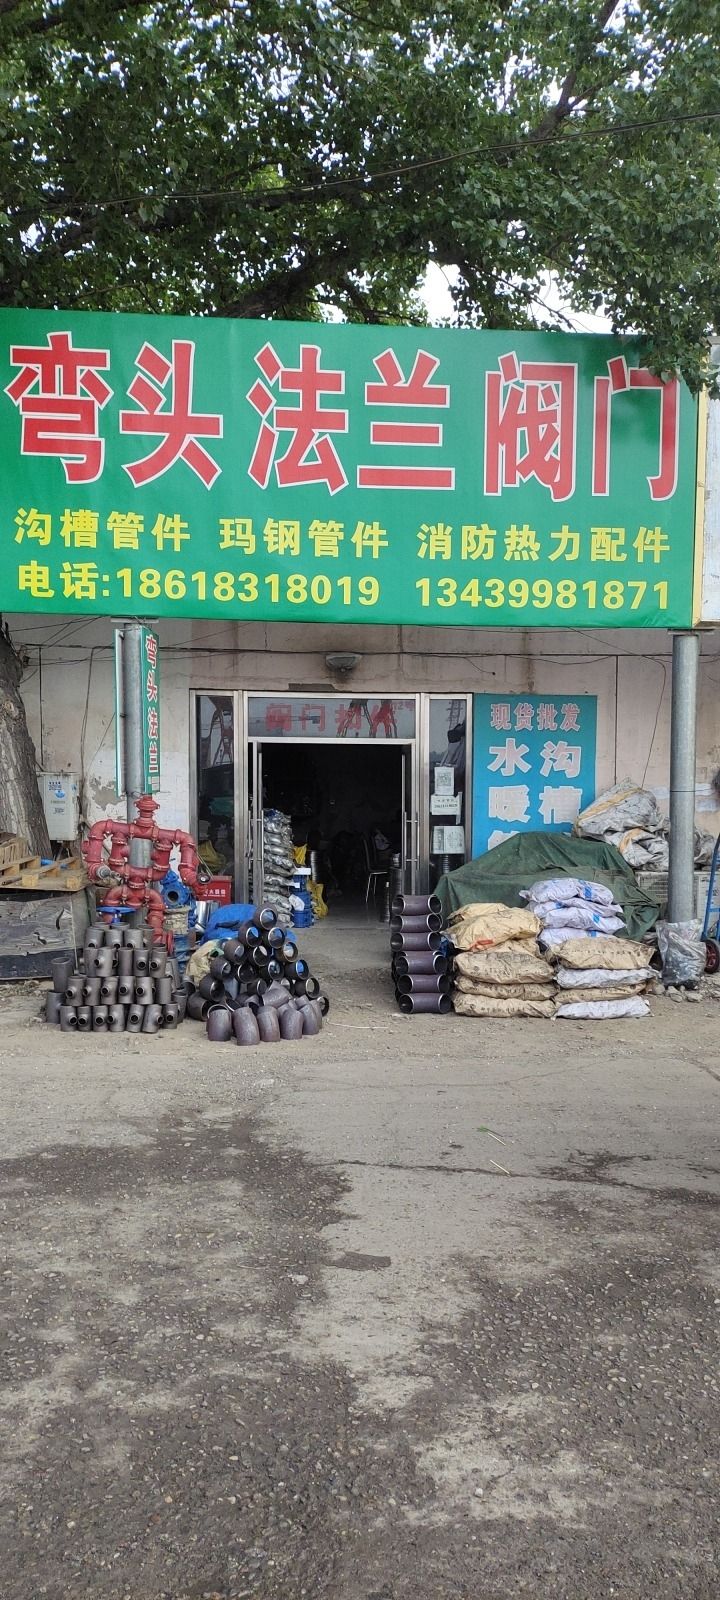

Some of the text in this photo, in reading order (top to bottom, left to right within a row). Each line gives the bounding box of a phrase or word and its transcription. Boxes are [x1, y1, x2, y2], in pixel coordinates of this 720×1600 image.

[3, 331, 680, 502] 弯头 法兰 阀门
[14, 507, 670, 563] 沟槽管件 玛钢管件 消防热力配件
[18, 560, 669, 610] 电话:18618318019 13439981871
[146, 634, 159, 773] 弯头法兰
[490, 703, 581, 732] 现货批发
[487, 738, 532, 850] 水暖
